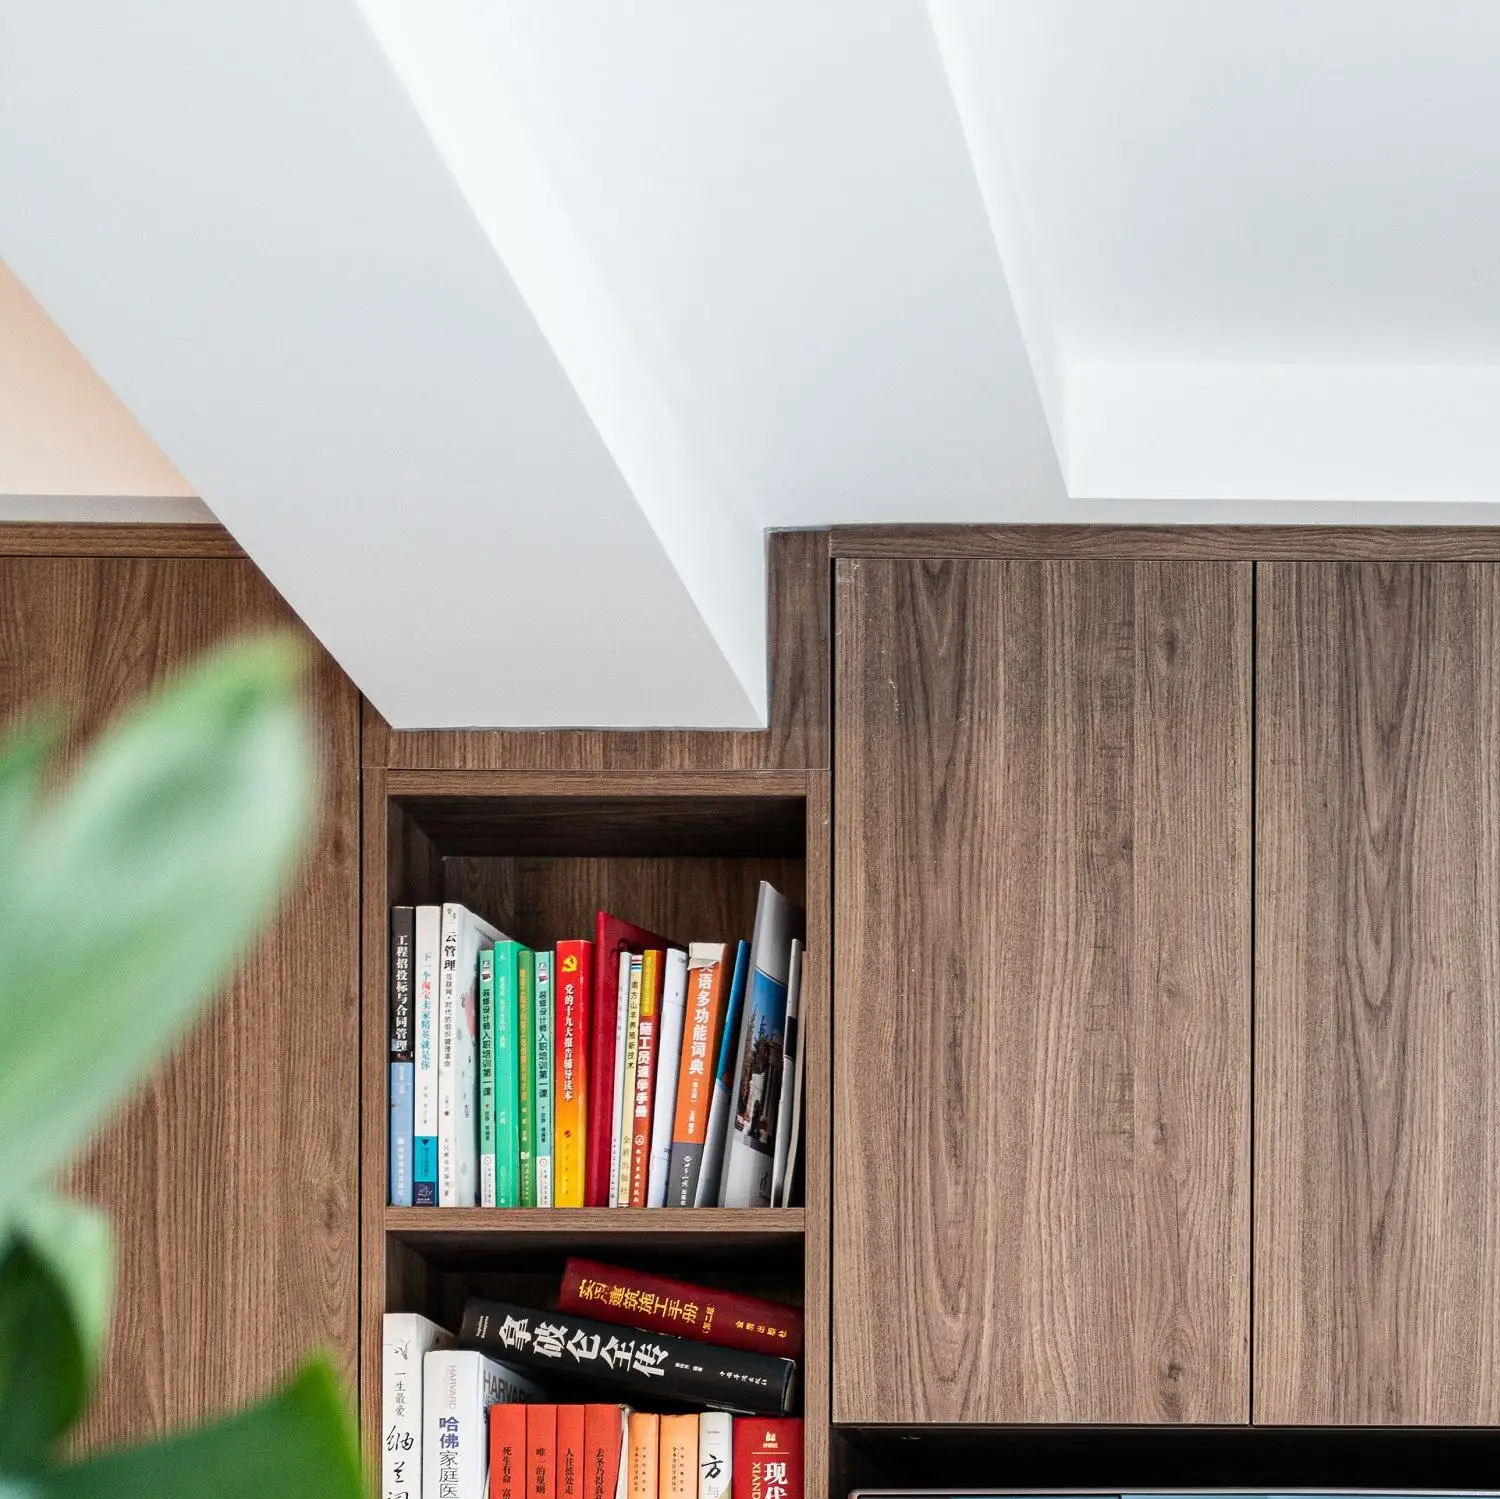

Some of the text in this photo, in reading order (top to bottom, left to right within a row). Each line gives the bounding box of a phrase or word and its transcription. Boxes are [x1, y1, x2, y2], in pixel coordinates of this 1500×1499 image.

[443, 931, 457, 971] 云管理
[395, 934, 409, 1051] 工程招投标与合同管理
[563, 983, 575, 1101] 党的十九大报告辅导读本
[577, 1277, 699, 1325] 实用建筑施工手册
[498, 1313, 670, 1378] 拿破仑全传
[394, 1371, 407, 1418] 一生最爱
[446, 1364, 458, 1411] HARVARD
[501, 1446, 514, 1484] 死生有命
[535, 1447, 546, 1495] 唯一的规则
[564, 1447, 575, 1495] 人往低处走
